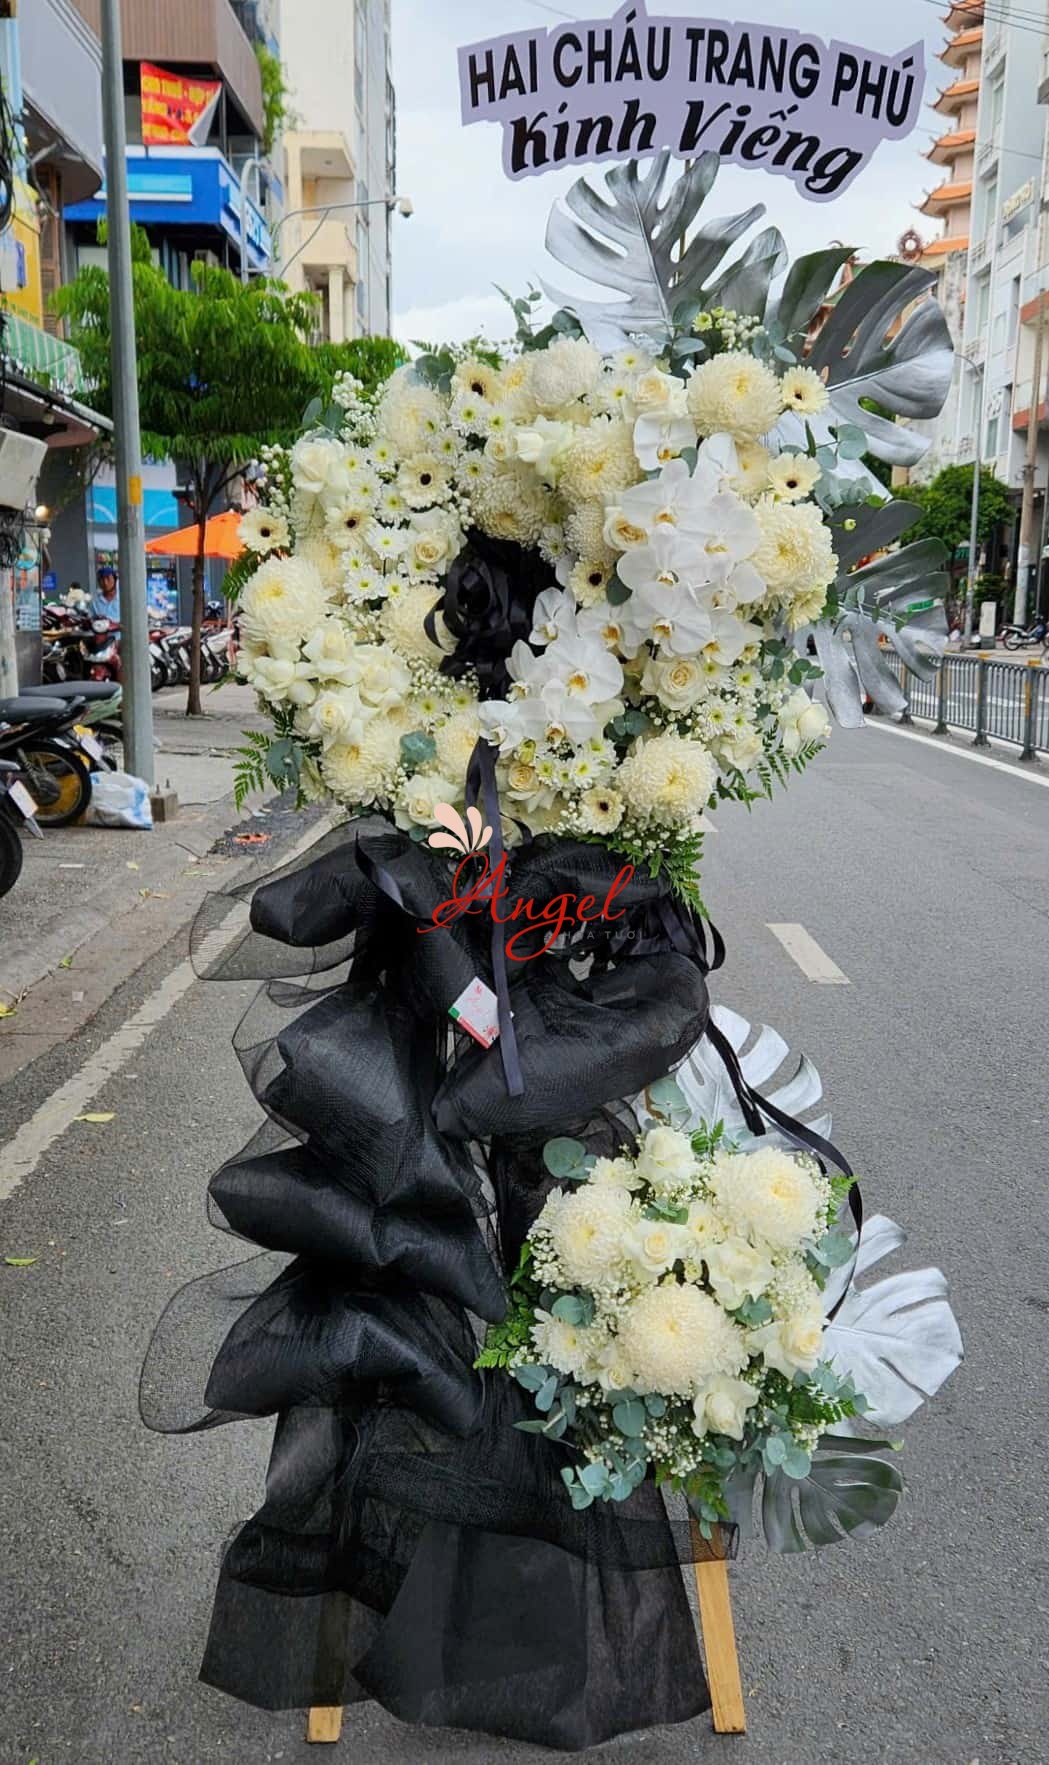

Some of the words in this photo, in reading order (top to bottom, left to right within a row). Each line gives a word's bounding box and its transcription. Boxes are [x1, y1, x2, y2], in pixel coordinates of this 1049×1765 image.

[469, 39, 538, 107] HAI
[552, 9, 671, 87] CHÁU
[686, 27, 820, 98] TRANG
[832, 52, 915, 126] PHÚ
[510, 99, 657, 173] Kính
[679, 101, 863, 194] Viếng
